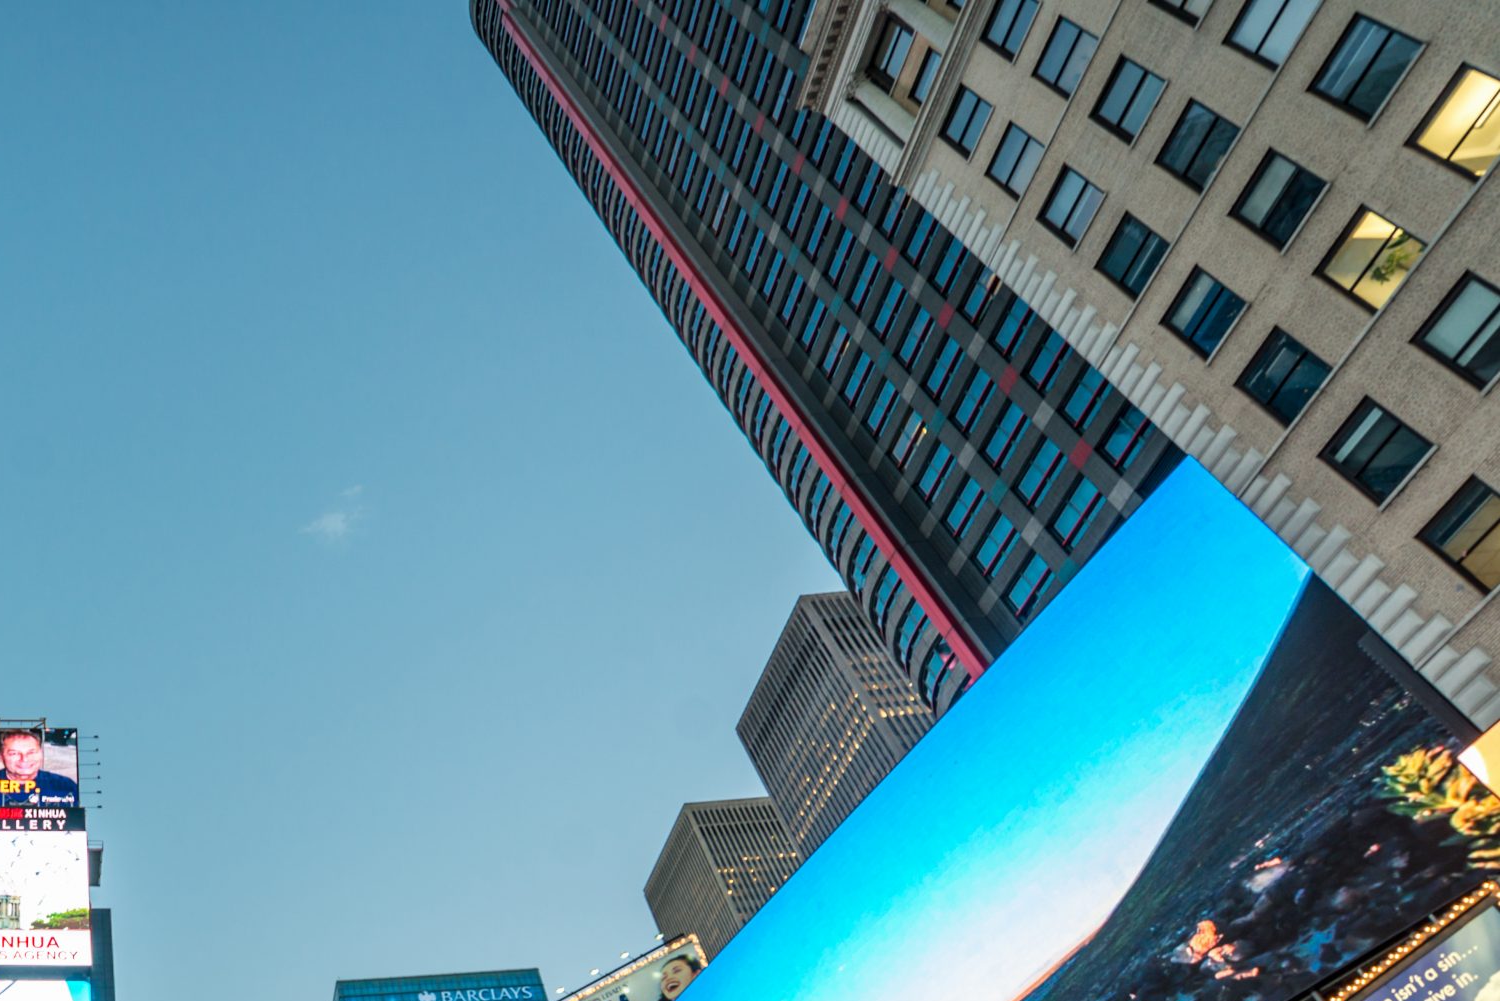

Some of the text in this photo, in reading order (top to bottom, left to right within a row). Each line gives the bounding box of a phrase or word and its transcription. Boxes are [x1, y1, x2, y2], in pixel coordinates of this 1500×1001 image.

[25, 779, 41, 794] P.
[24, 808, 67, 819] XINHUA
[12, 950, 79, 961] AGENCY
[1423, 967, 1438, 982] a
[1451, 971, 1479, 990] in.
